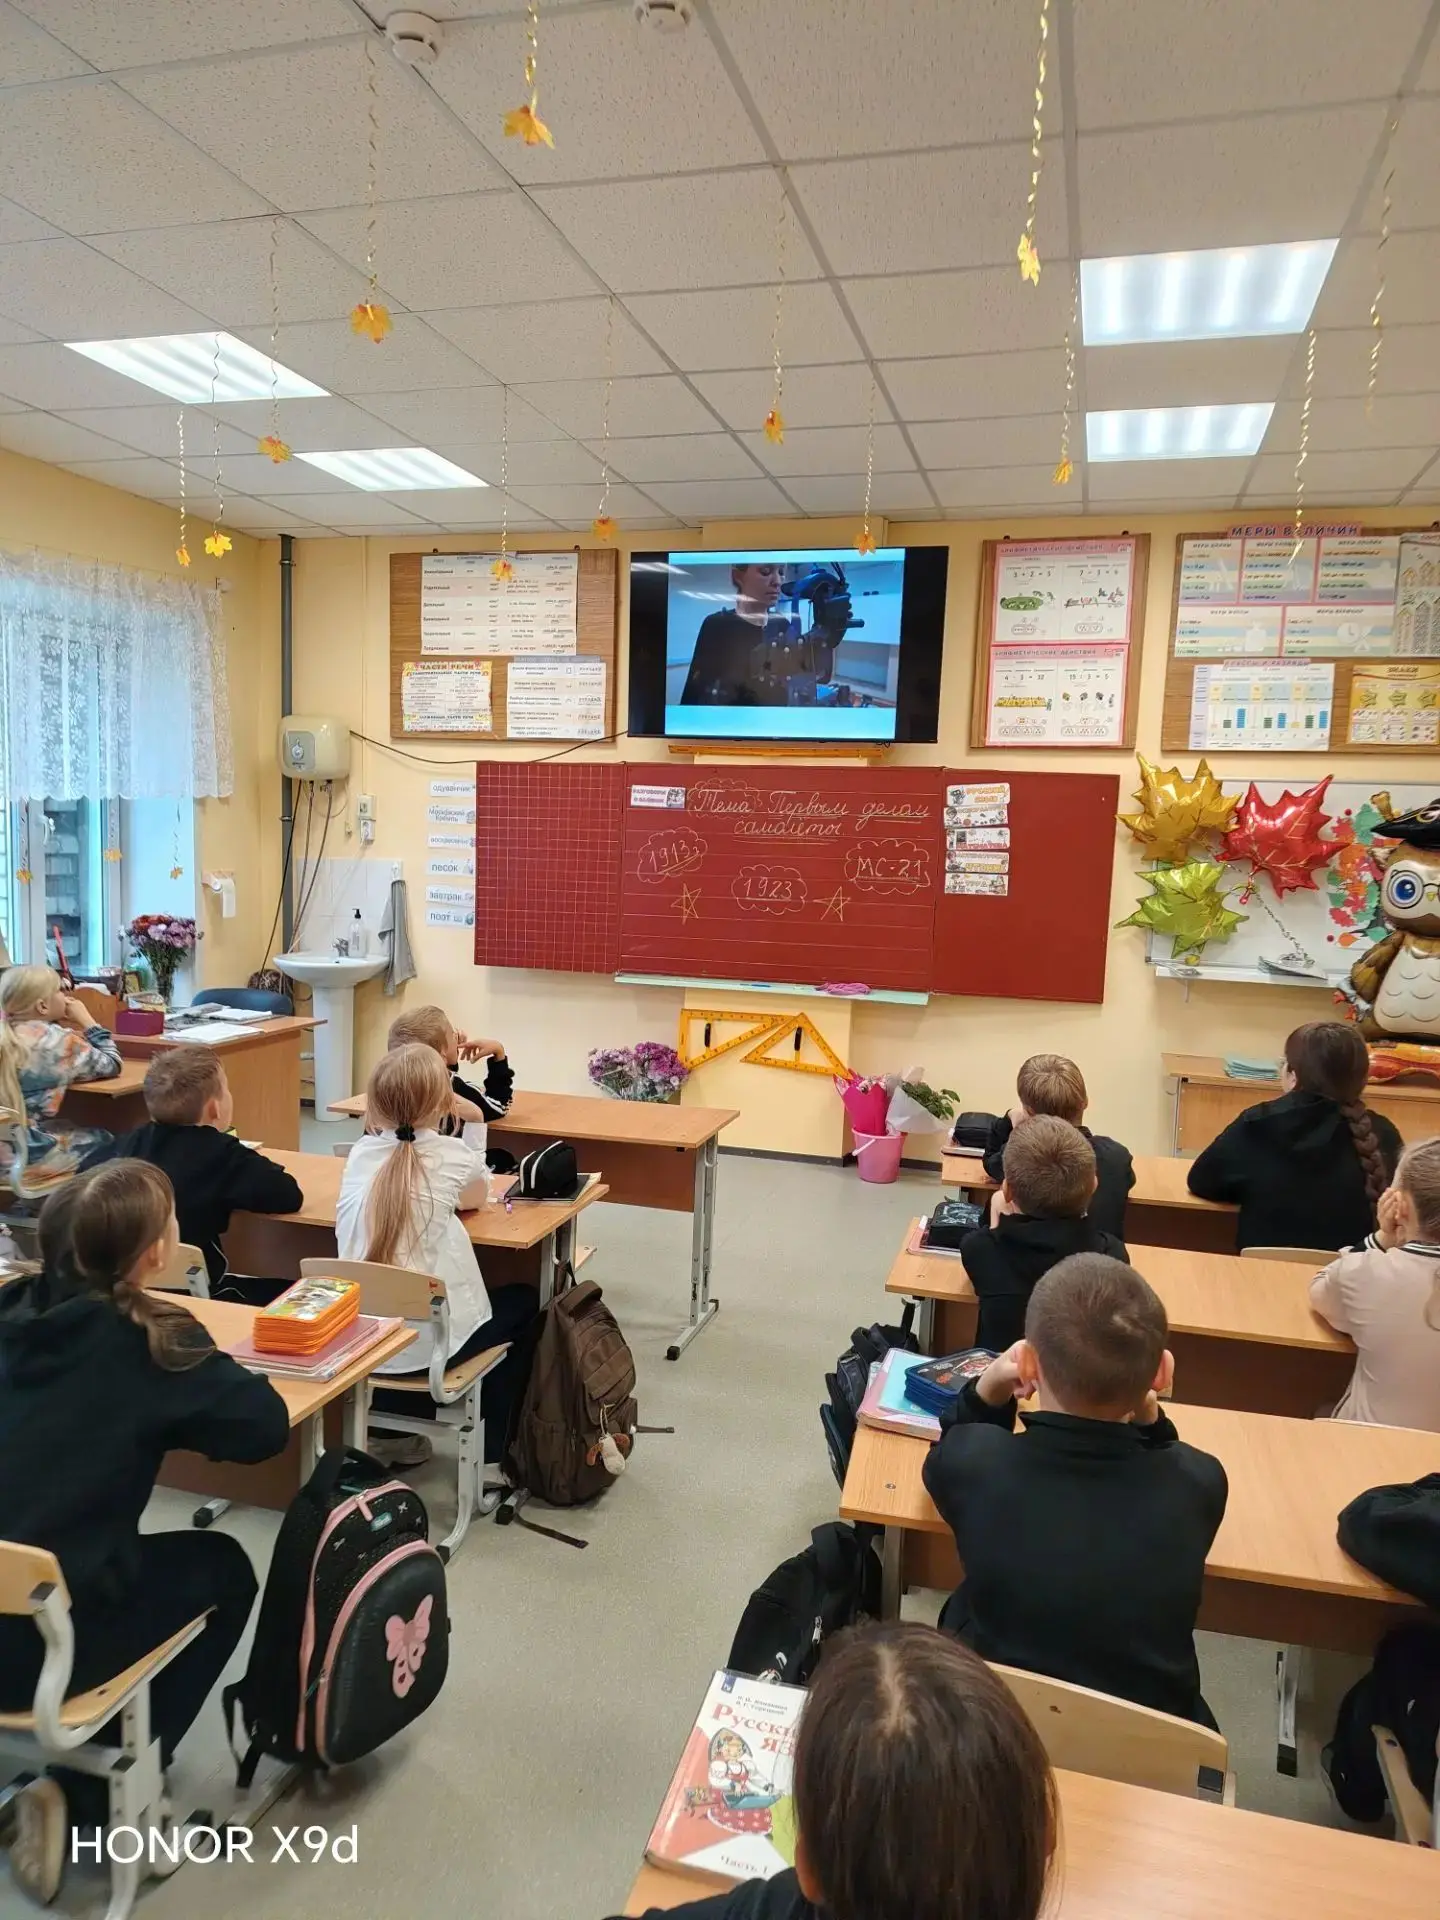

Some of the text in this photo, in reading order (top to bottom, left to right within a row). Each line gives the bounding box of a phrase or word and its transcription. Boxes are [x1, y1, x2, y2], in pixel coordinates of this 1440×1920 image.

[1231, 526, 1276, 537] МЕРЫ
[694, 788, 753, 812] Тема
[767, 790, 850, 824] Первым
[649, 840, 690, 872] 1913
[431, 864, 458, 872] песок
[743, 877, 793, 899] 1923
[430, 912, 451, 921] поэт
[711, 1702, 795, 1738] Русски
